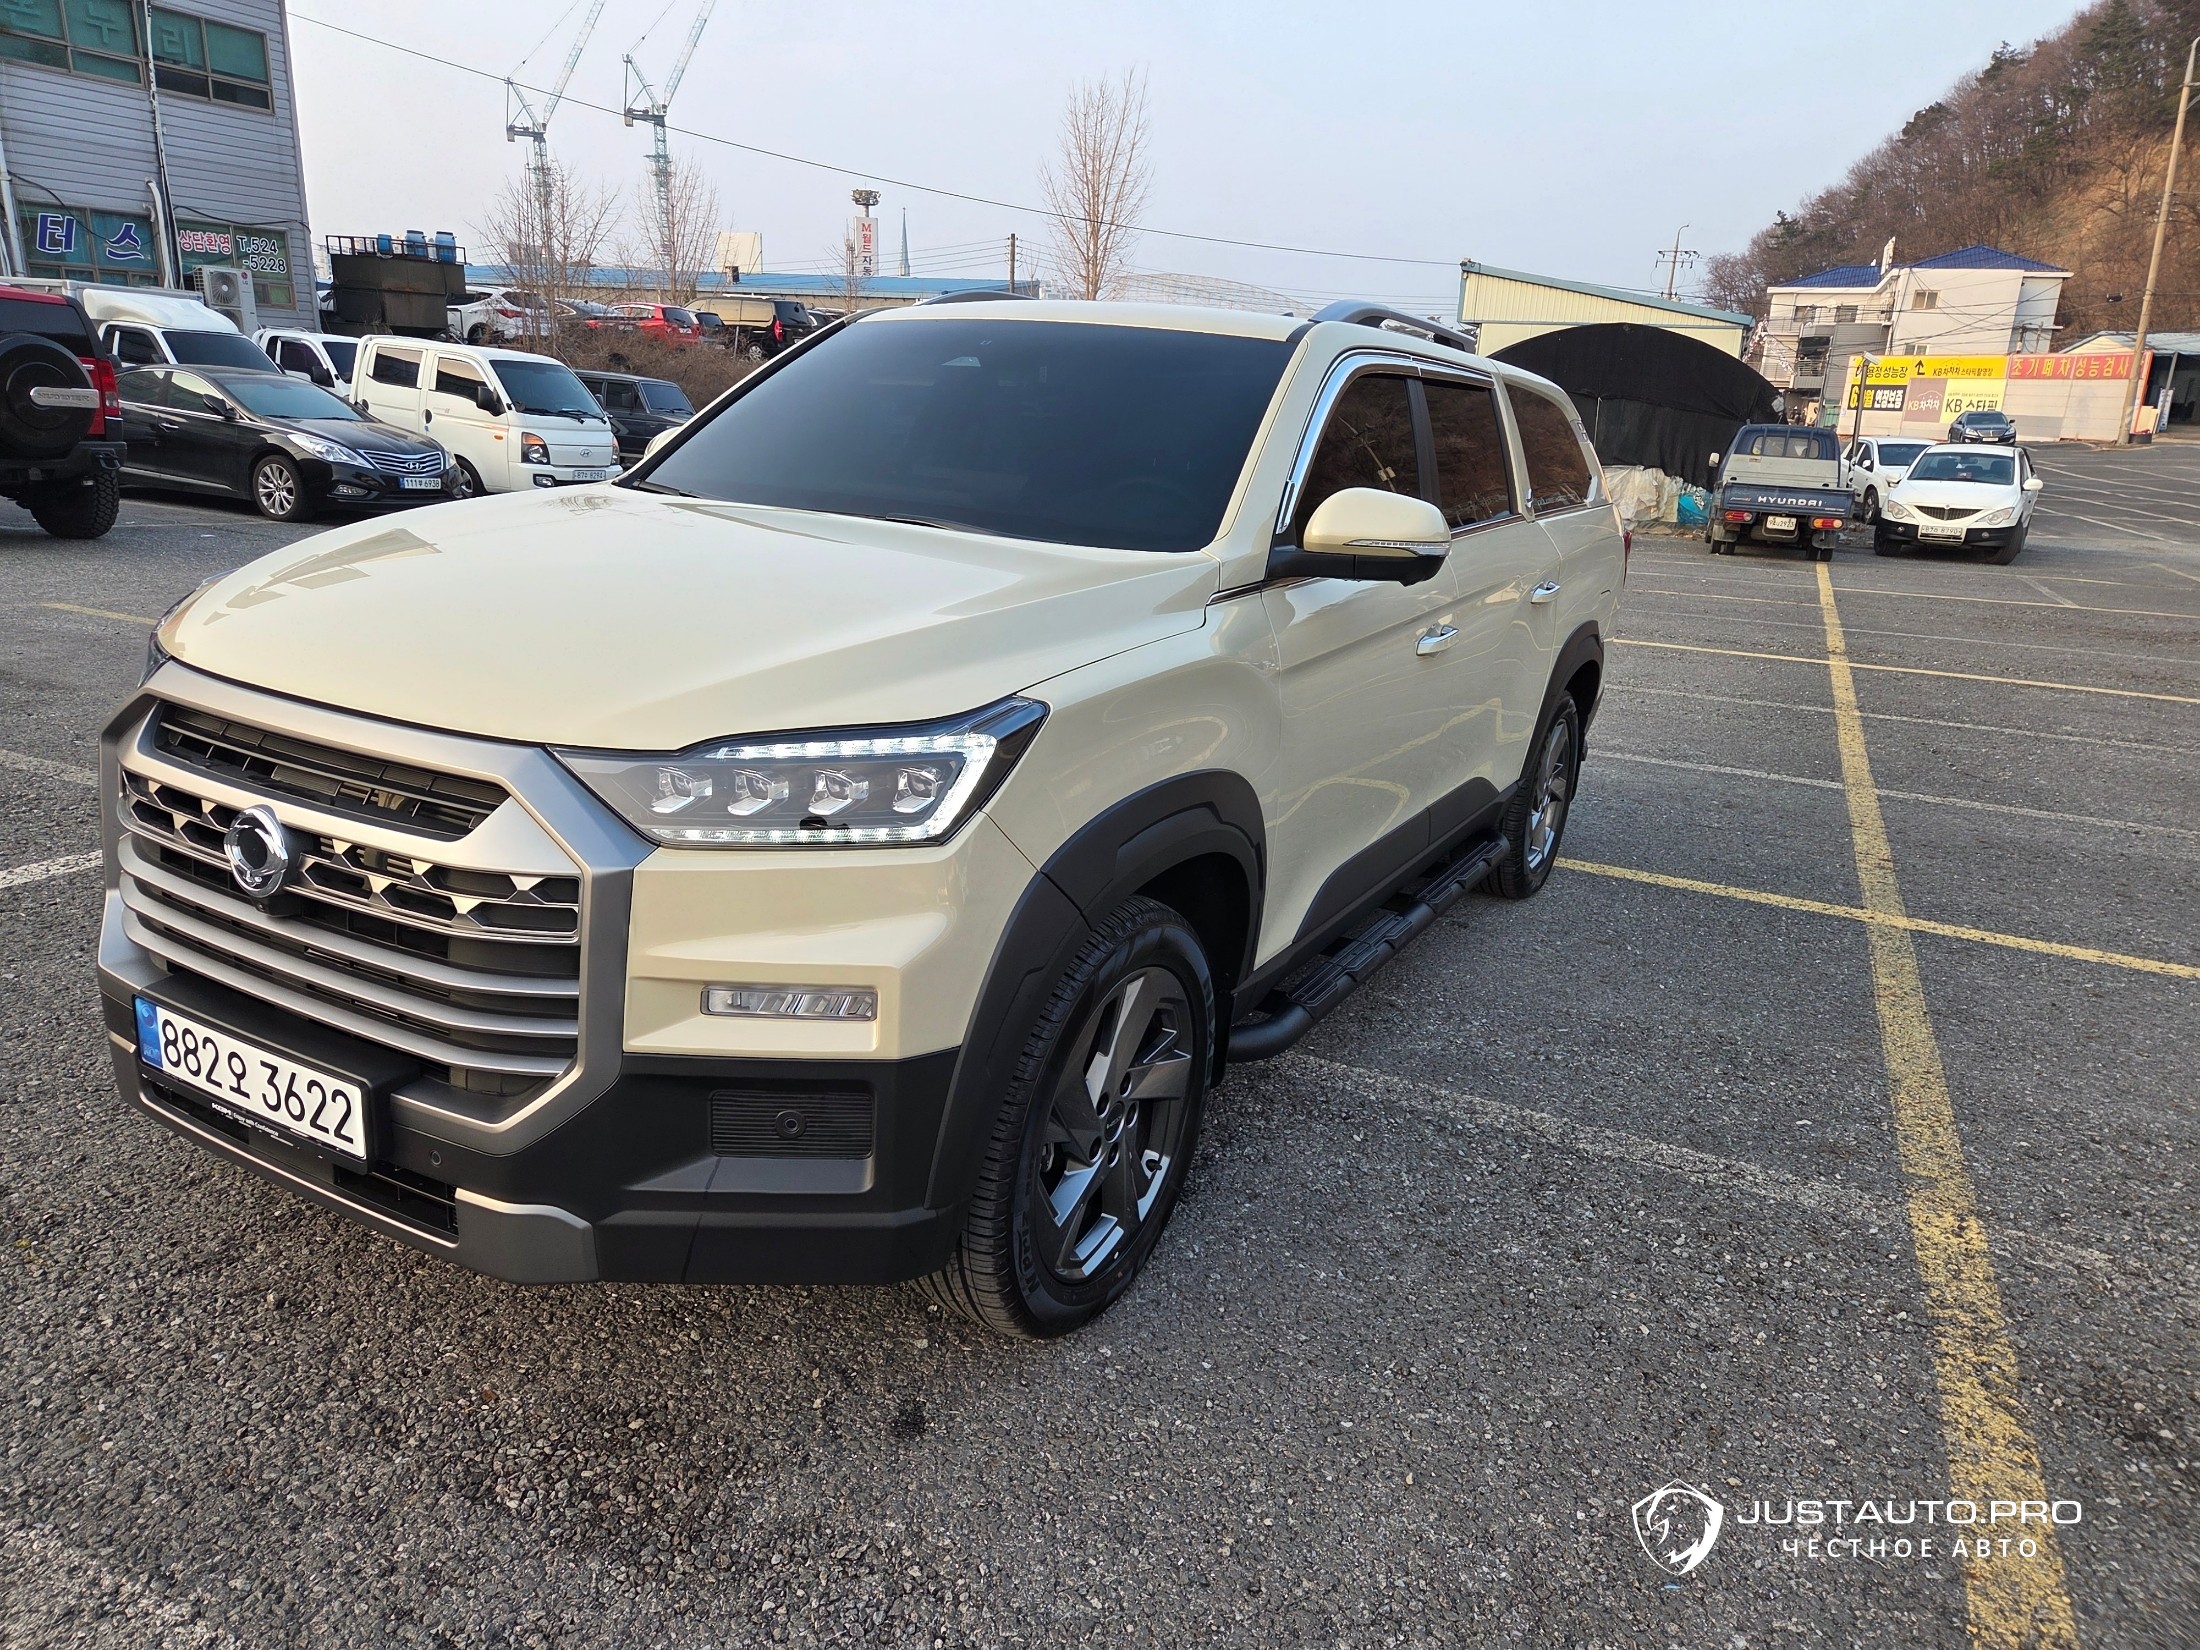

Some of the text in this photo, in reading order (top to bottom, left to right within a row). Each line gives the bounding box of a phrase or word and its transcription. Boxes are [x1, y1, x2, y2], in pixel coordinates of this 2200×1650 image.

[179, 230, 232, 255] 상담환영
[236, 235, 277, 254] T.524
[243, 254, 286, 273] -5228
[1946, 398, 1962, 413] KB
[1757, 495, 1823, 507] HYUNDAI
[161, 1018, 355, 1146] 882오 3622
